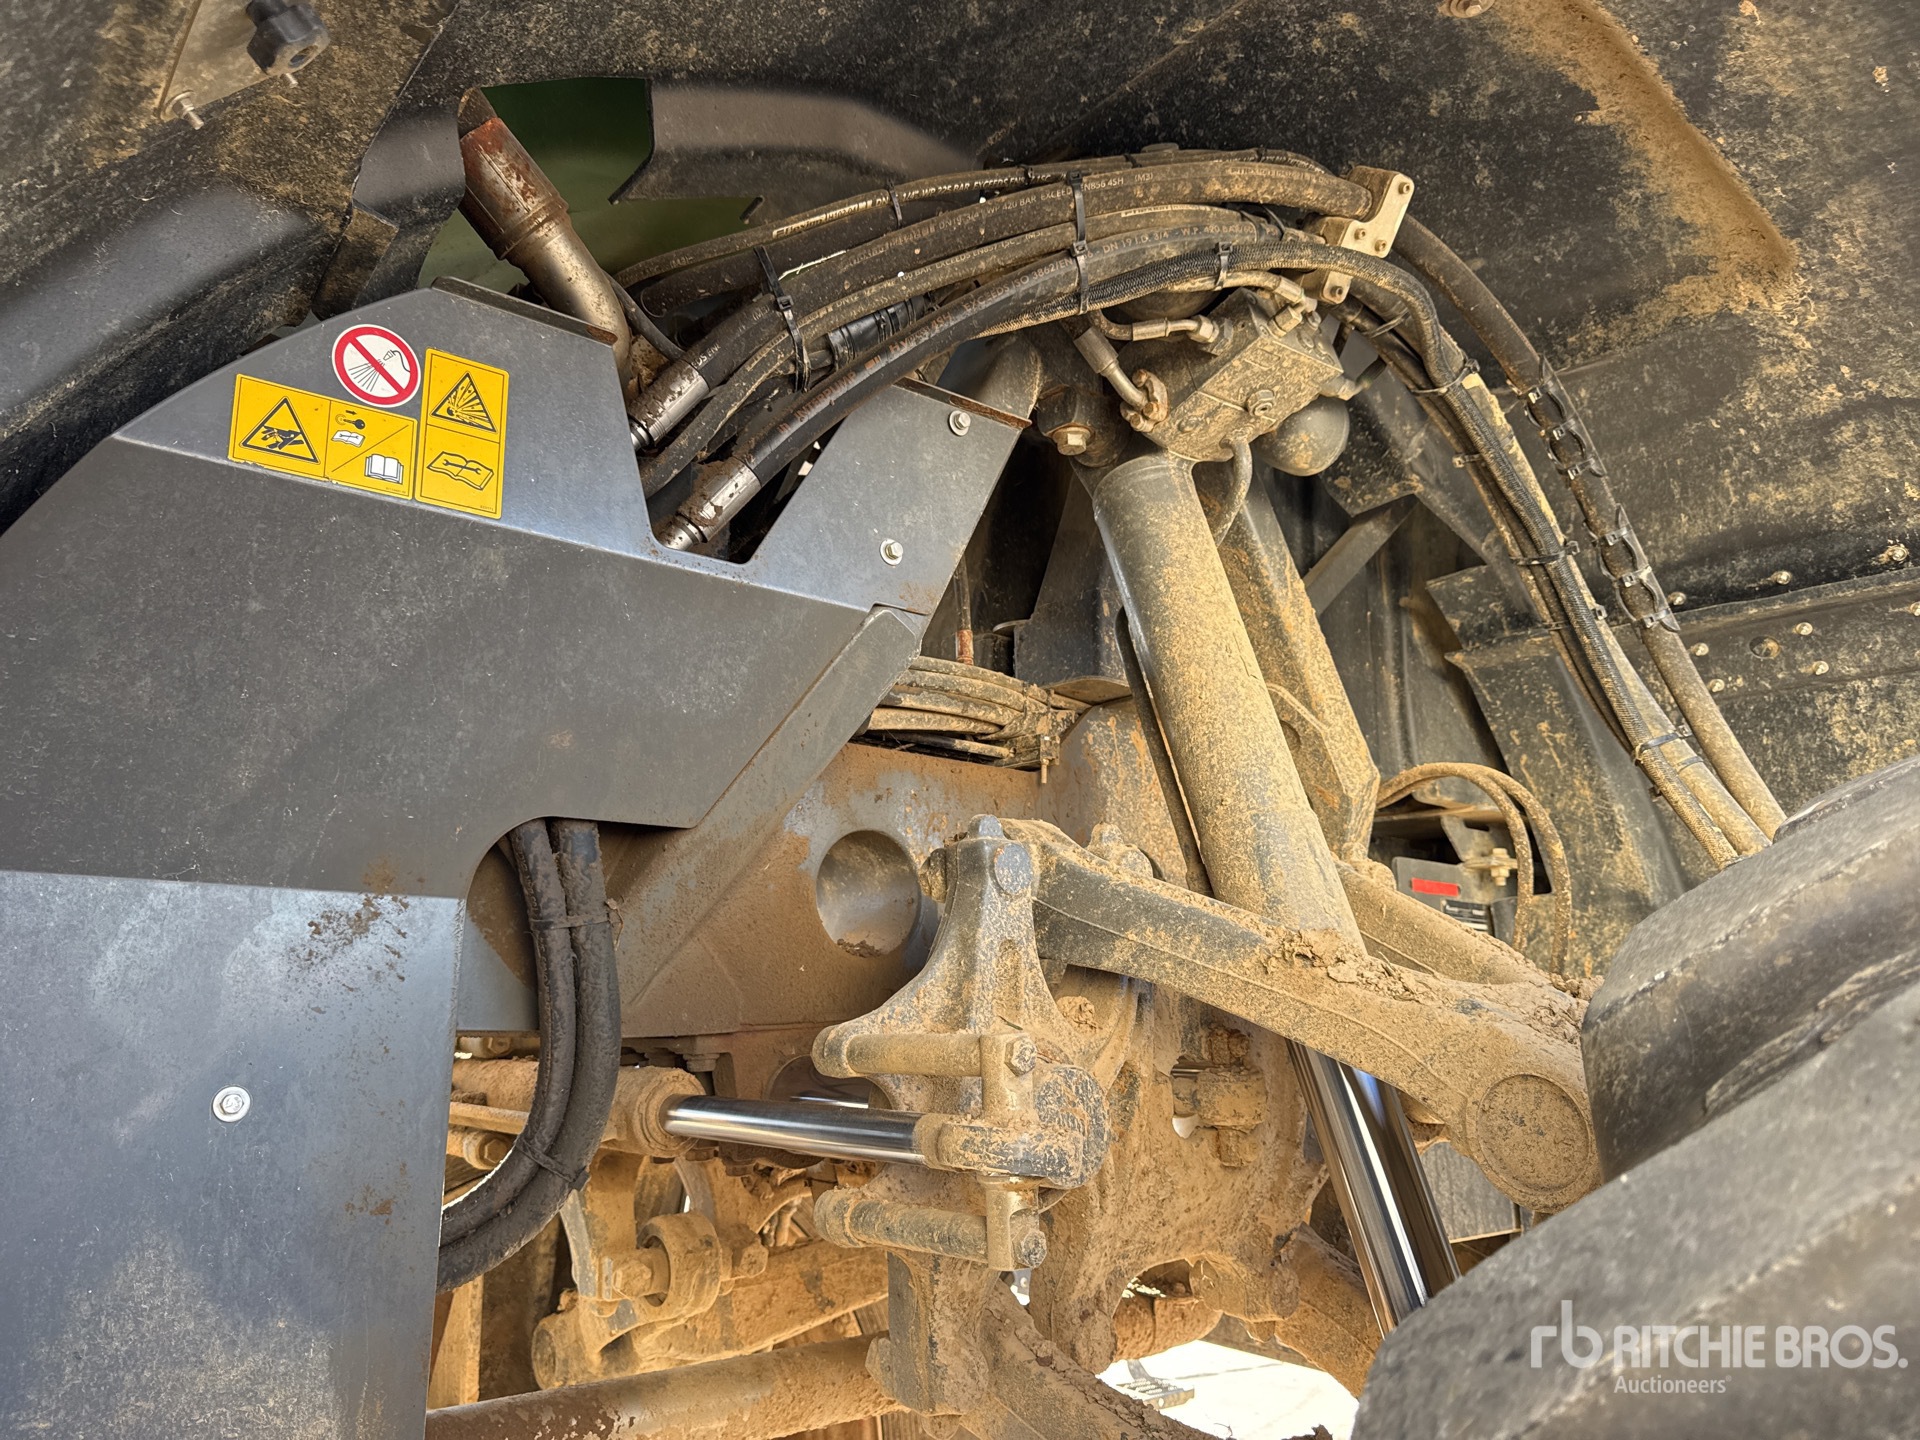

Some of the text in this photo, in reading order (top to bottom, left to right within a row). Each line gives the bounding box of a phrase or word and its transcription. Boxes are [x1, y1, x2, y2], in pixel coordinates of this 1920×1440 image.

[953, 182, 969, 192] BAR
[974, 177, 1009, 190] EXCEEDS
[1019, 195, 1037, 206] BAR
[1041, 187, 1077, 200] EXCEED
[794, 371, 857, 420] INTERPUMP
[963, 282, 1010, 311] EXCEEDS
[1012, 274, 1030, 289] ISO
[1103, 241, 1118, 254] DN
